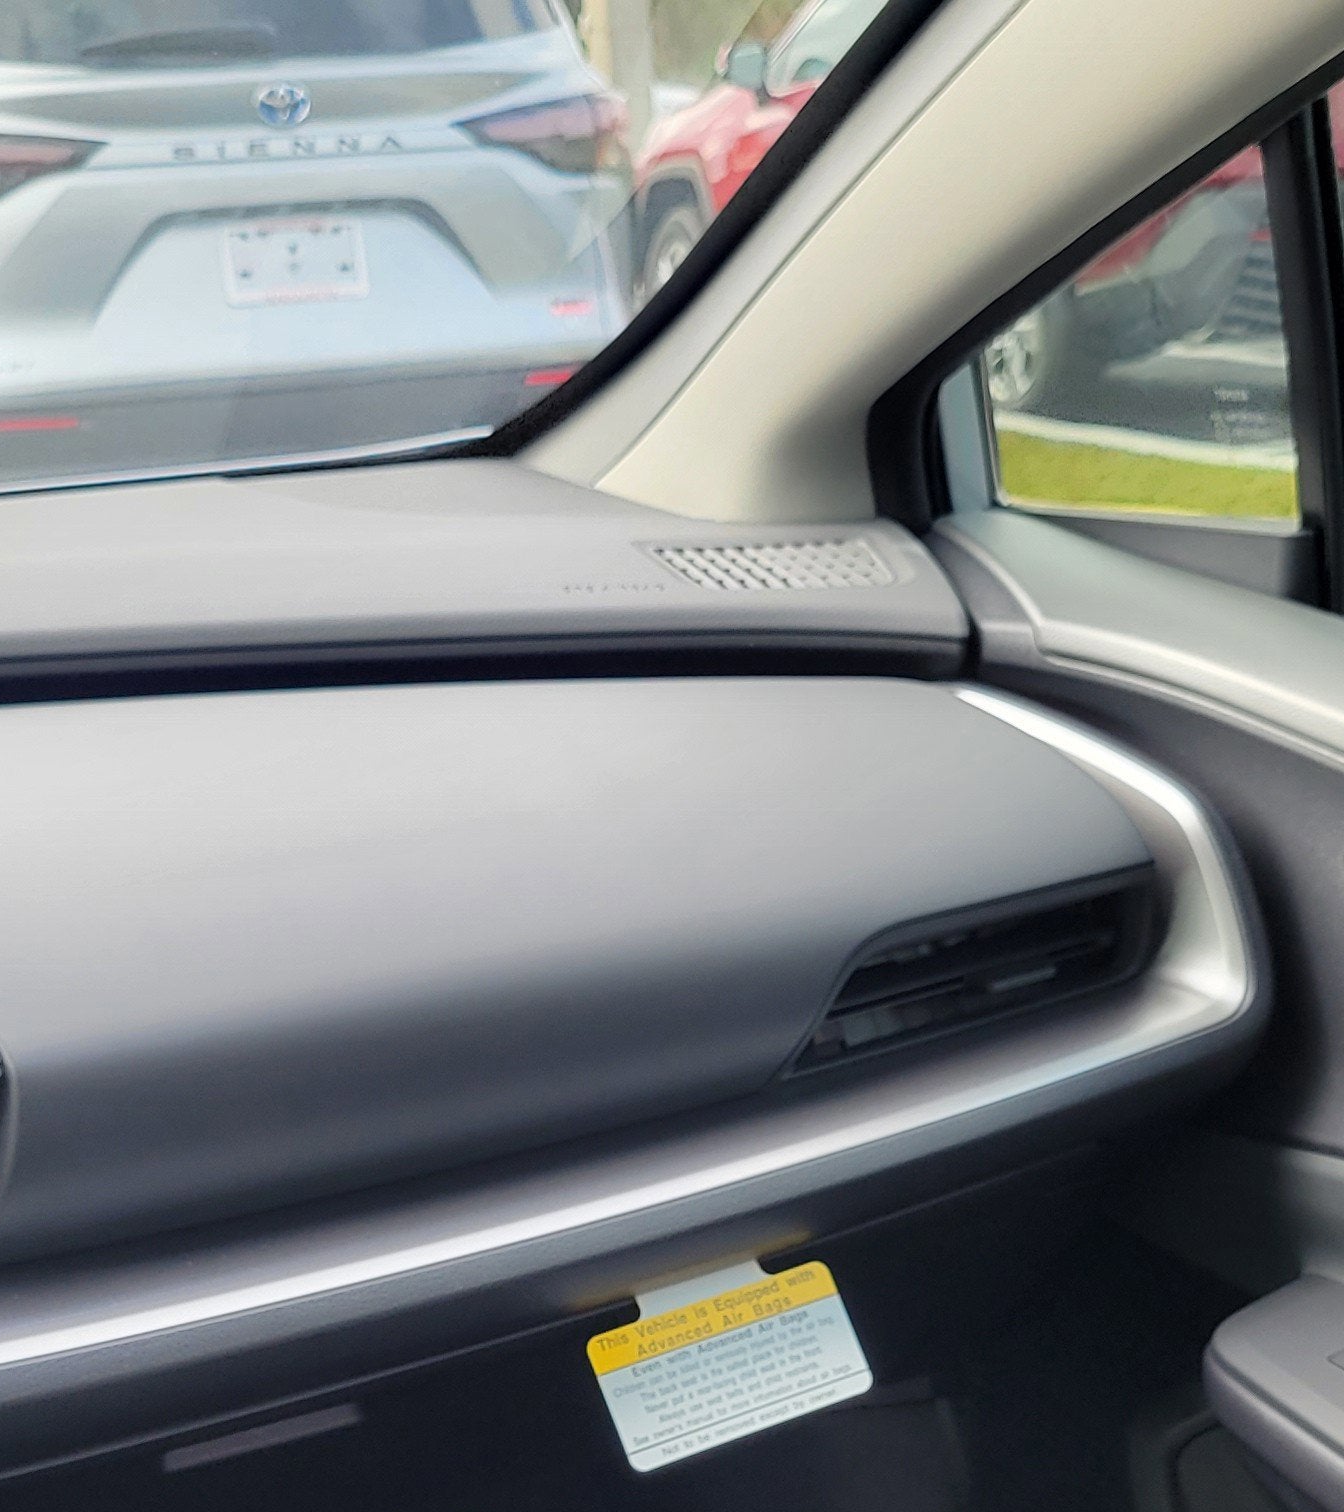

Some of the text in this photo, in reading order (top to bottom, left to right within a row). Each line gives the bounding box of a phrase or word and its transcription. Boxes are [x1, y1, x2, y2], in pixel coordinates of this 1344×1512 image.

[173, 136, 402, 160] SIENNA
[597, 1331, 629, 1352] This
[636, 1311, 687, 1338] Vehicle
[713, 1280, 779, 1313] Equipped
[785, 1267, 815, 1287] with
[636, 1295, 791, 1357] Advanced Air Bags
[631, 1309, 809, 1377] Even with Advanced Air Bags
